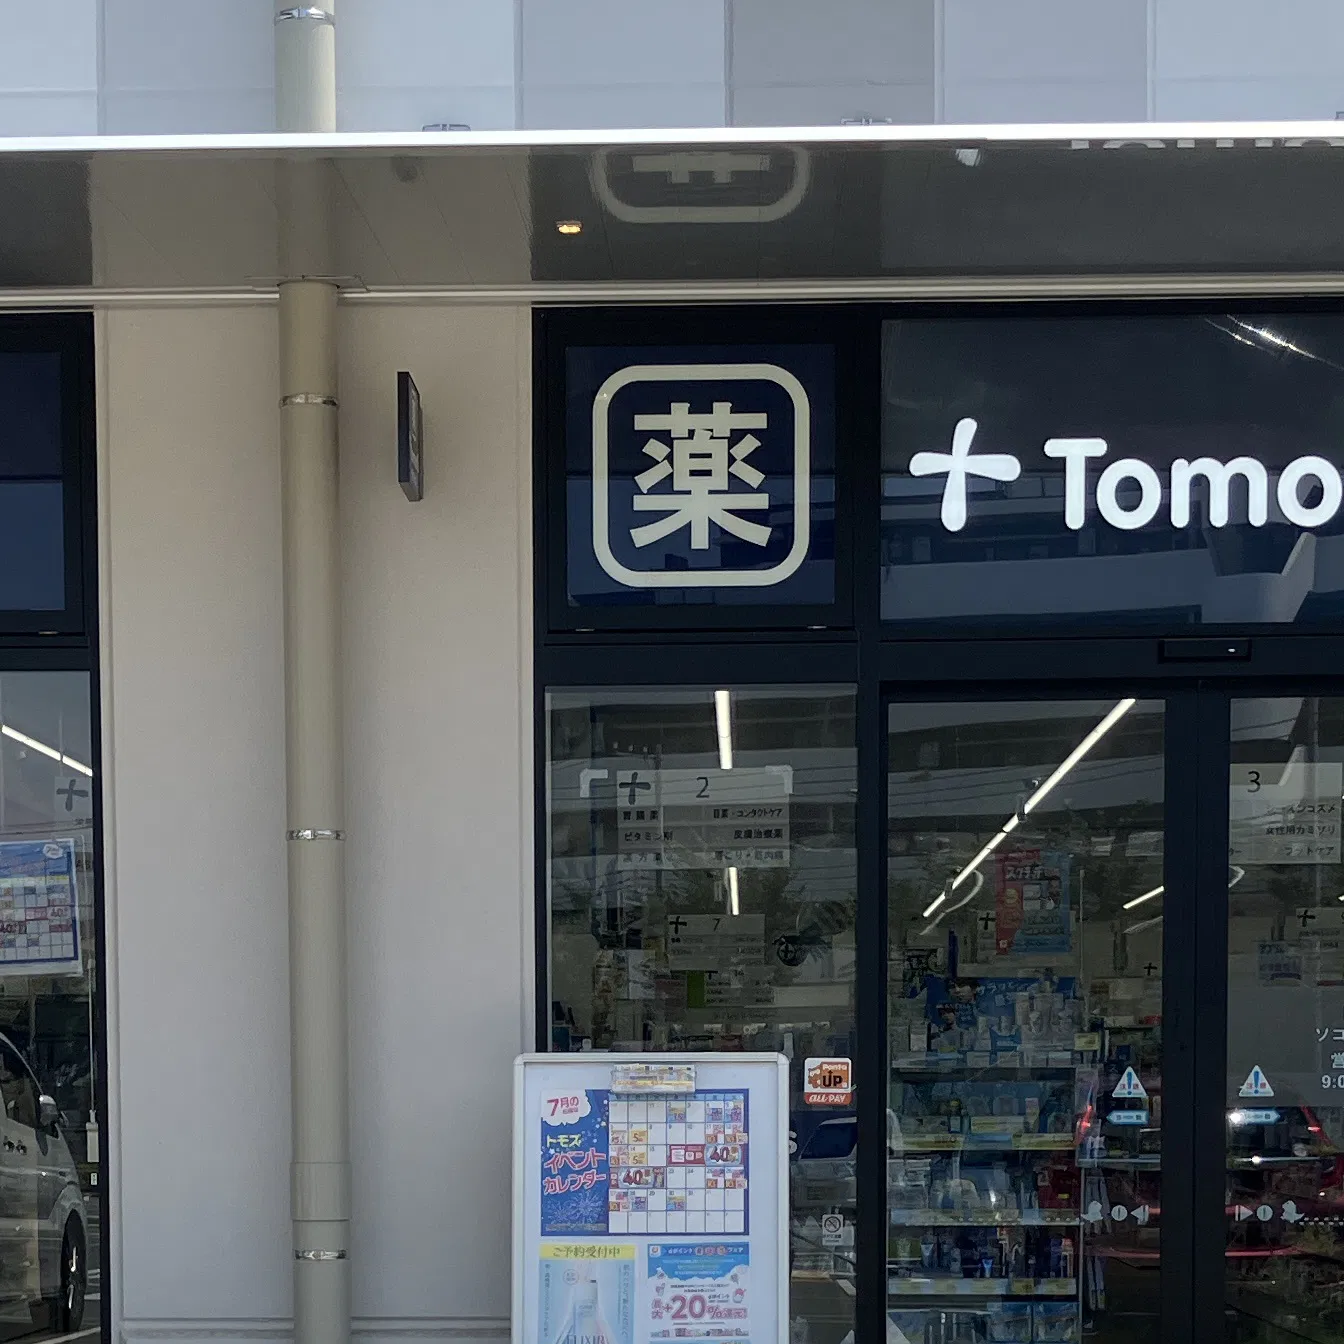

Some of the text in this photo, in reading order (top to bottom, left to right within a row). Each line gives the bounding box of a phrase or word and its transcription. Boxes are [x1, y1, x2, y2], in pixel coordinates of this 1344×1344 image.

[630, 400, 772, 551] 薬
[696, 776, 710, 799] 2
[1247, 770, 1261, 793] 3
[822, 1071, 844, 1088] UP
[546, 1133, 583, 1148] トモズ
[544, 1147, 607, 1175] イベント
[543, 1169, 607, 1196] カレンダー
[553, 1245, 621, 1259] ご予約受付中
